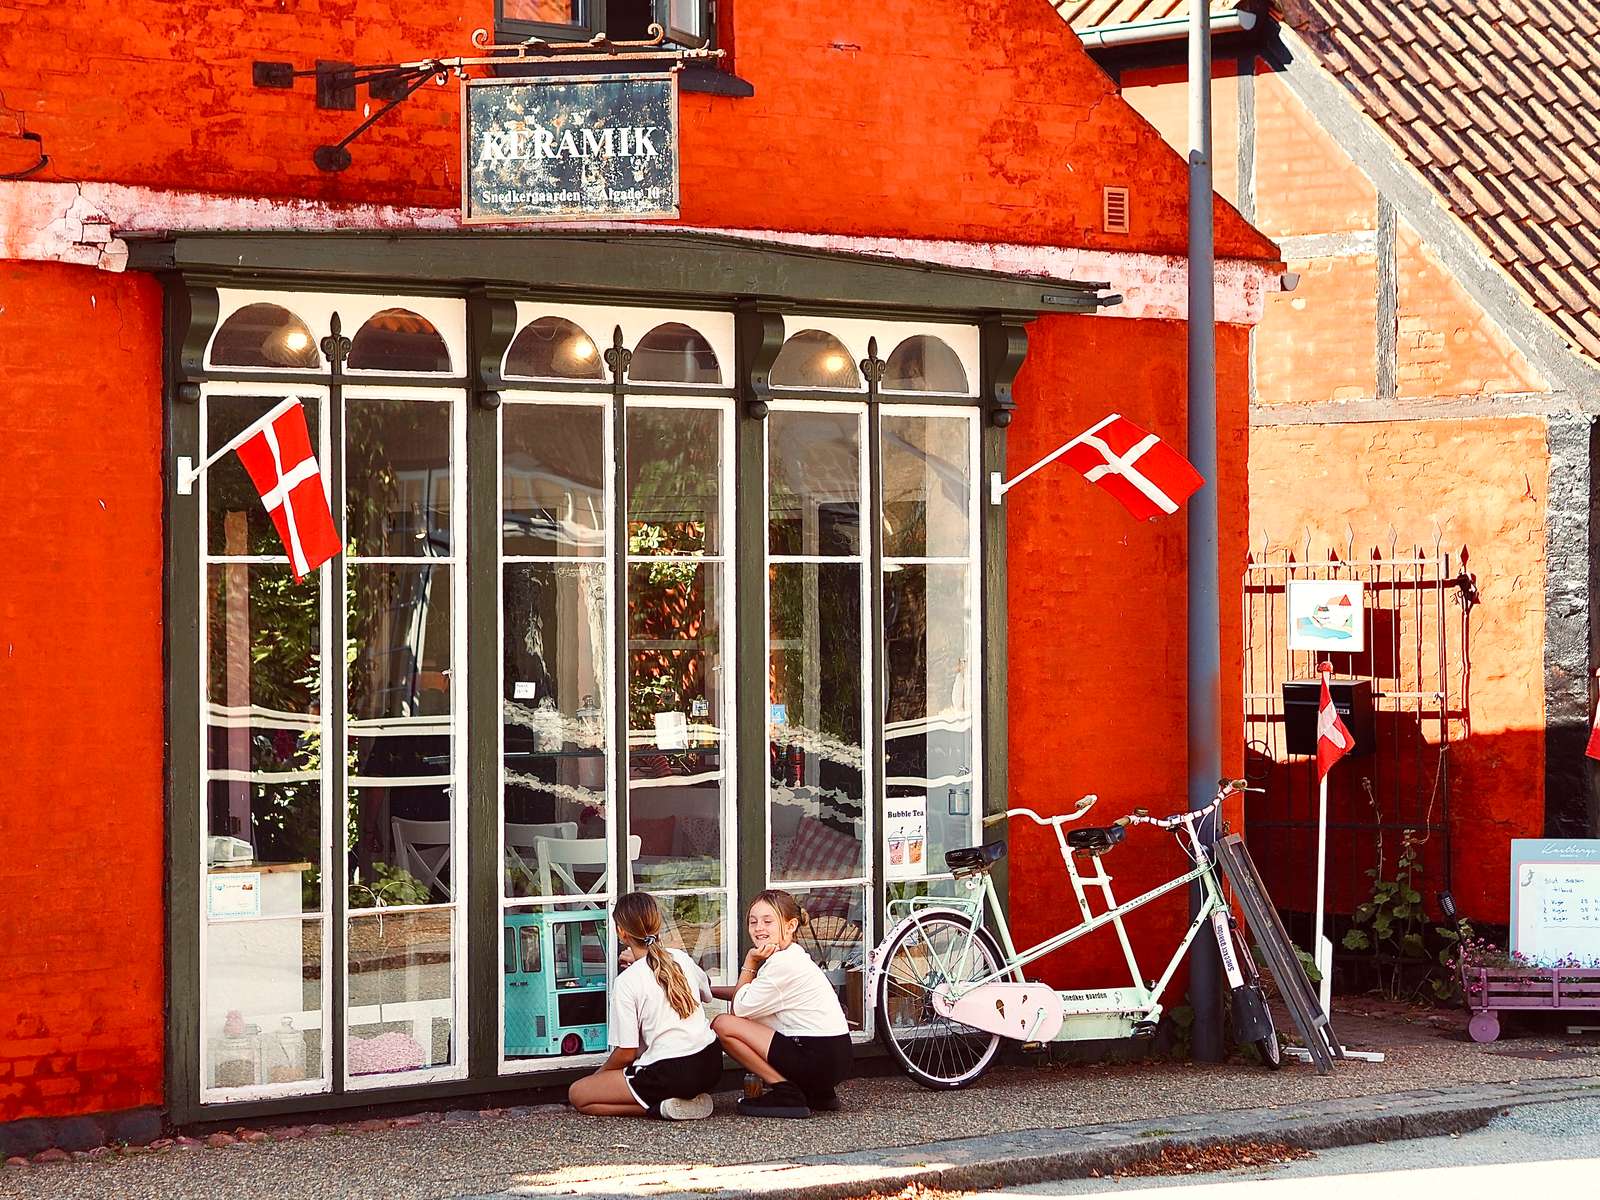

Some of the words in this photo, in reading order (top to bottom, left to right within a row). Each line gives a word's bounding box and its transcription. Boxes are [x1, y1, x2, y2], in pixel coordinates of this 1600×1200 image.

[480, 126, 660, 161] KERAMIK
[482, 189, 581, 204] Snedkergaarden
[598, 187, 641, 203] Algade
[646, 185, 660, 199] 10
[887, 811, 912, 819] Bubble
